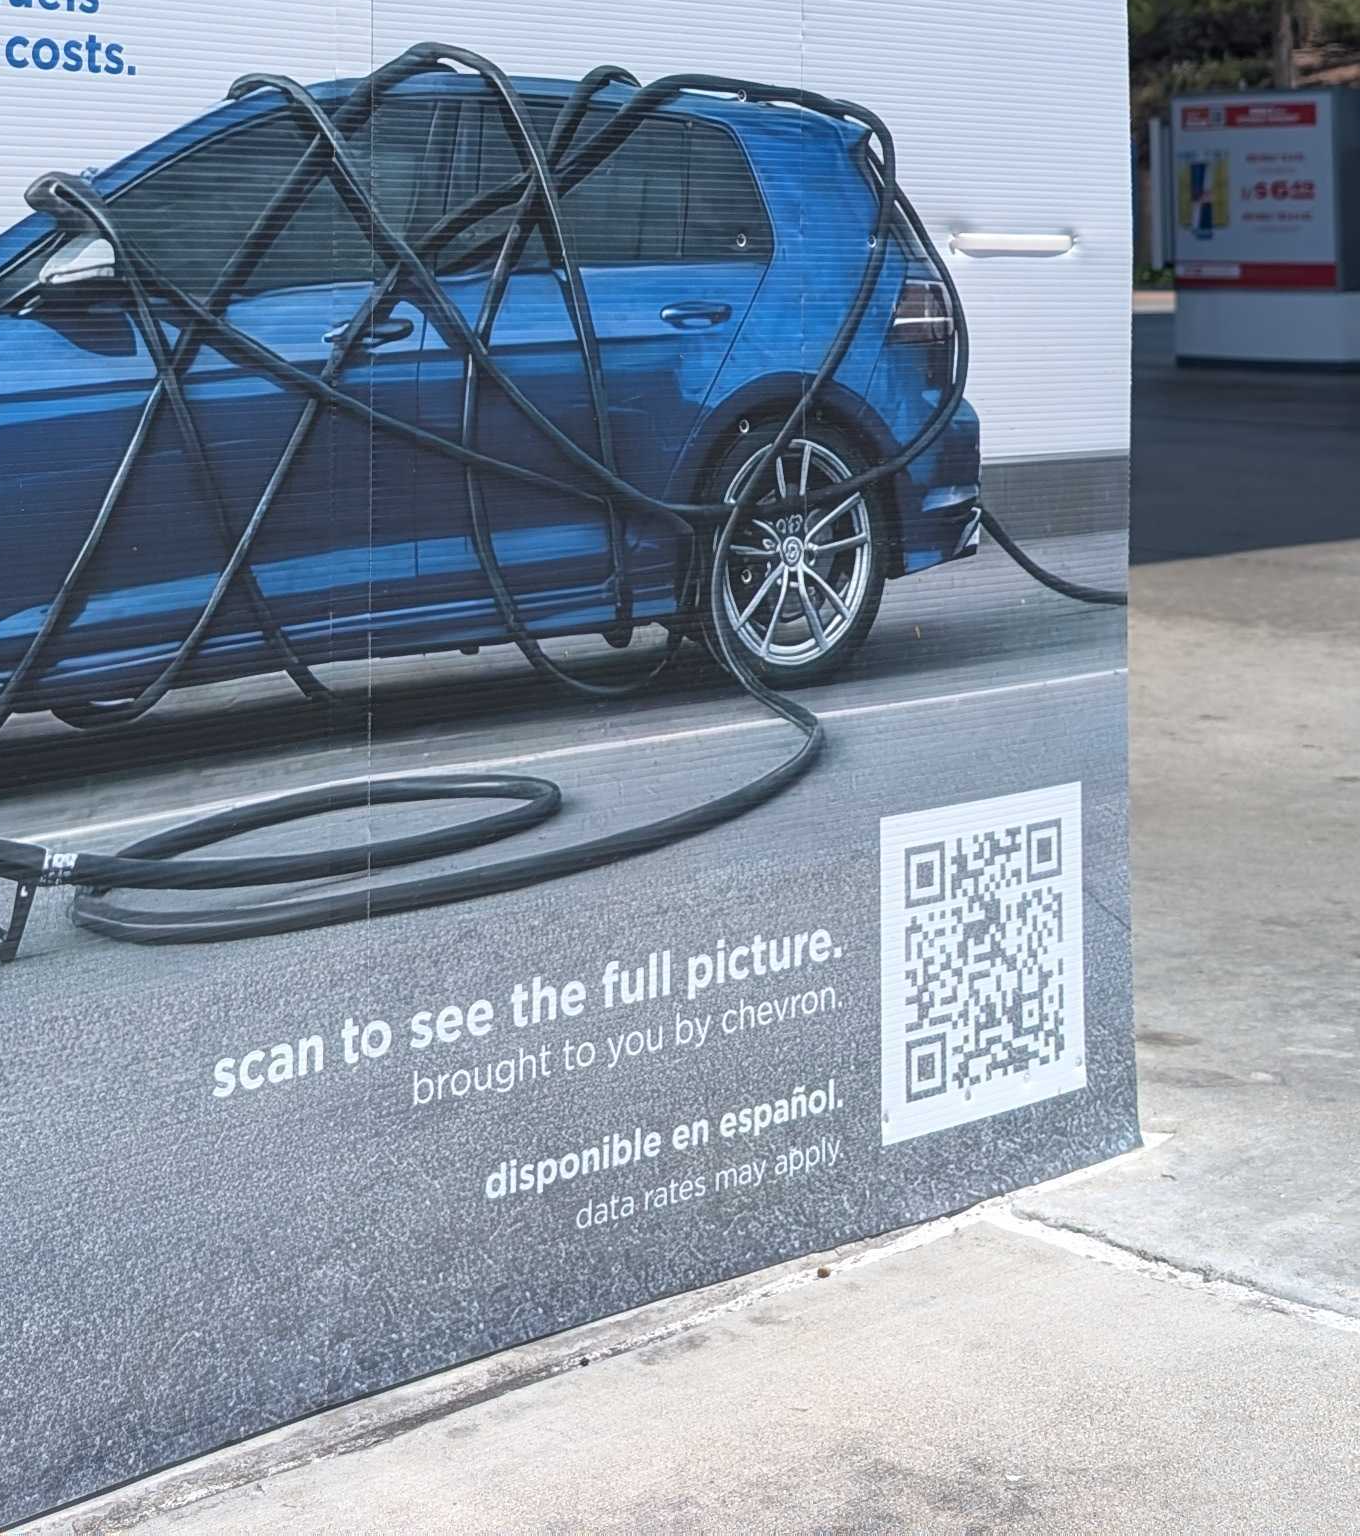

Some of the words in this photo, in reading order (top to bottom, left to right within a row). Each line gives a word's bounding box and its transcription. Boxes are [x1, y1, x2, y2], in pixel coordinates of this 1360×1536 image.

[4, 34, 137, 77] costs.
[211, 1034, 325, 1099] scan
[340, 1016, 393, 1065] to
[409, 998, 495, 1049] see
[510, 975, 587, 1028] the
[601, 949, 671, 1009] full
[687, 927, 842, 1001] picture.
[412, 1041, 552, 1106] brought
[562, 1038, 596, 1071] to
[607, 1025, 663, 1068] you
[675, 1011, 711, 1049] by
[721, 985, 843, 1035] chevron.
[484, 1127, 662, 1199] disponible
[671, 1117, 709, 1151] en
[719, 1078, 844, 1137] español.
[575, 1195, 636, 1230] data
[642, 1175, 707, 1212] rates
[714, 1157, 767, 1192] may
[773, 1136, 844, 1178] apply.
